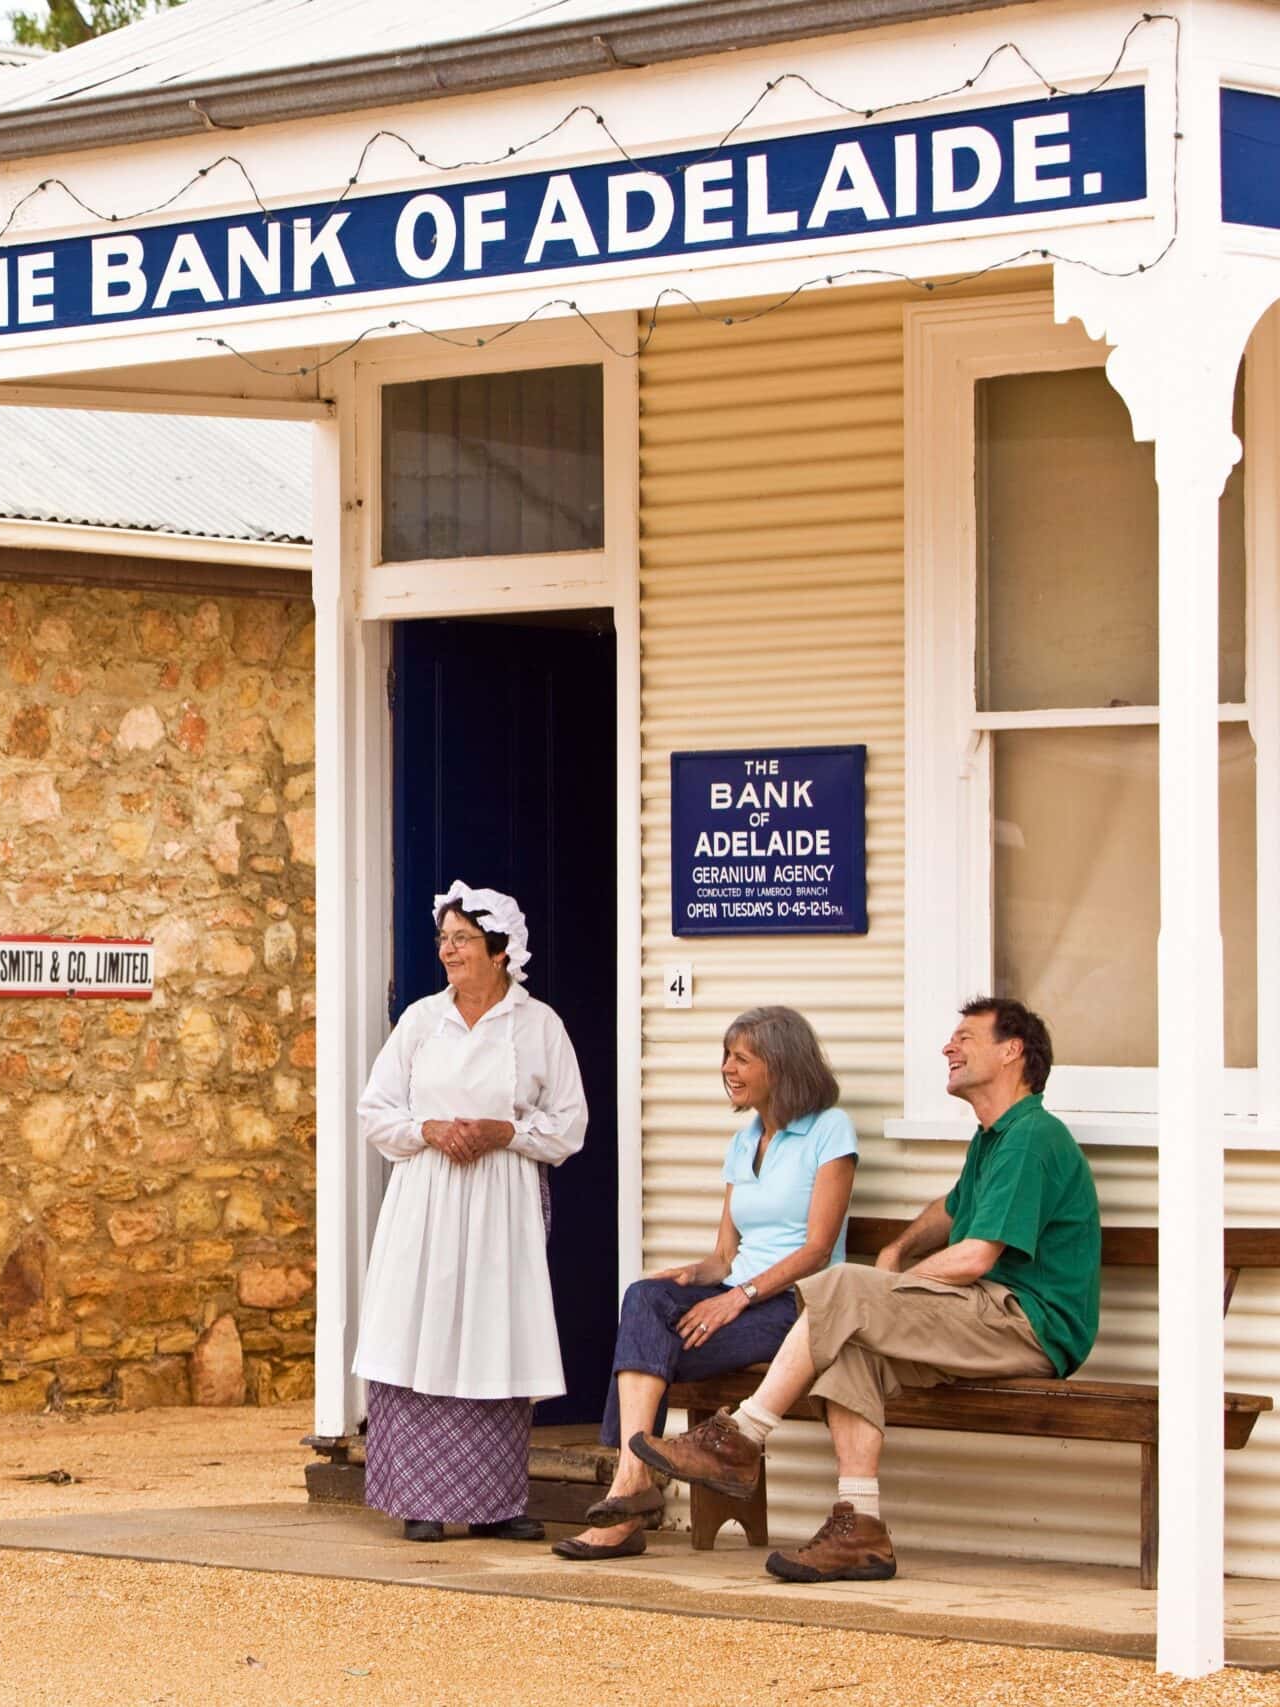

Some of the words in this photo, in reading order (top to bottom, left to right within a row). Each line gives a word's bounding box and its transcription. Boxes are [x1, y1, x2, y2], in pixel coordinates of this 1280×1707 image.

[90, 211, 357, 316] BANK
[394, 190, 506, 279] OF
[524, 111, 1102, 264] ADELAIDE.
[744, 760, 780, 775] THE
[710, 780, 814, 810] BANK
[749, 812, 770, 827] OF
[694, 830, 831, 857] ADELAIDE
[692, 865, 767, 885] GERANIUM
[773, 864, 835, 883] AGENCY
[697, 887, 742, 898] CONDUCTED
[745, 887, 755, 898] BY
[757, 887, 792, 897] LAMEROO
[796, 887, 828, 897] BRANCH
[687, 903, 717, 918] OPEN
[721, 902, 773, 918] TUESDAYS
[0, 950, 43, 983] SMITH
[50, 951, 60, 983] &
[95, 951, 152, 984] LIMITED.
[670, 976, 684, 996] 4
